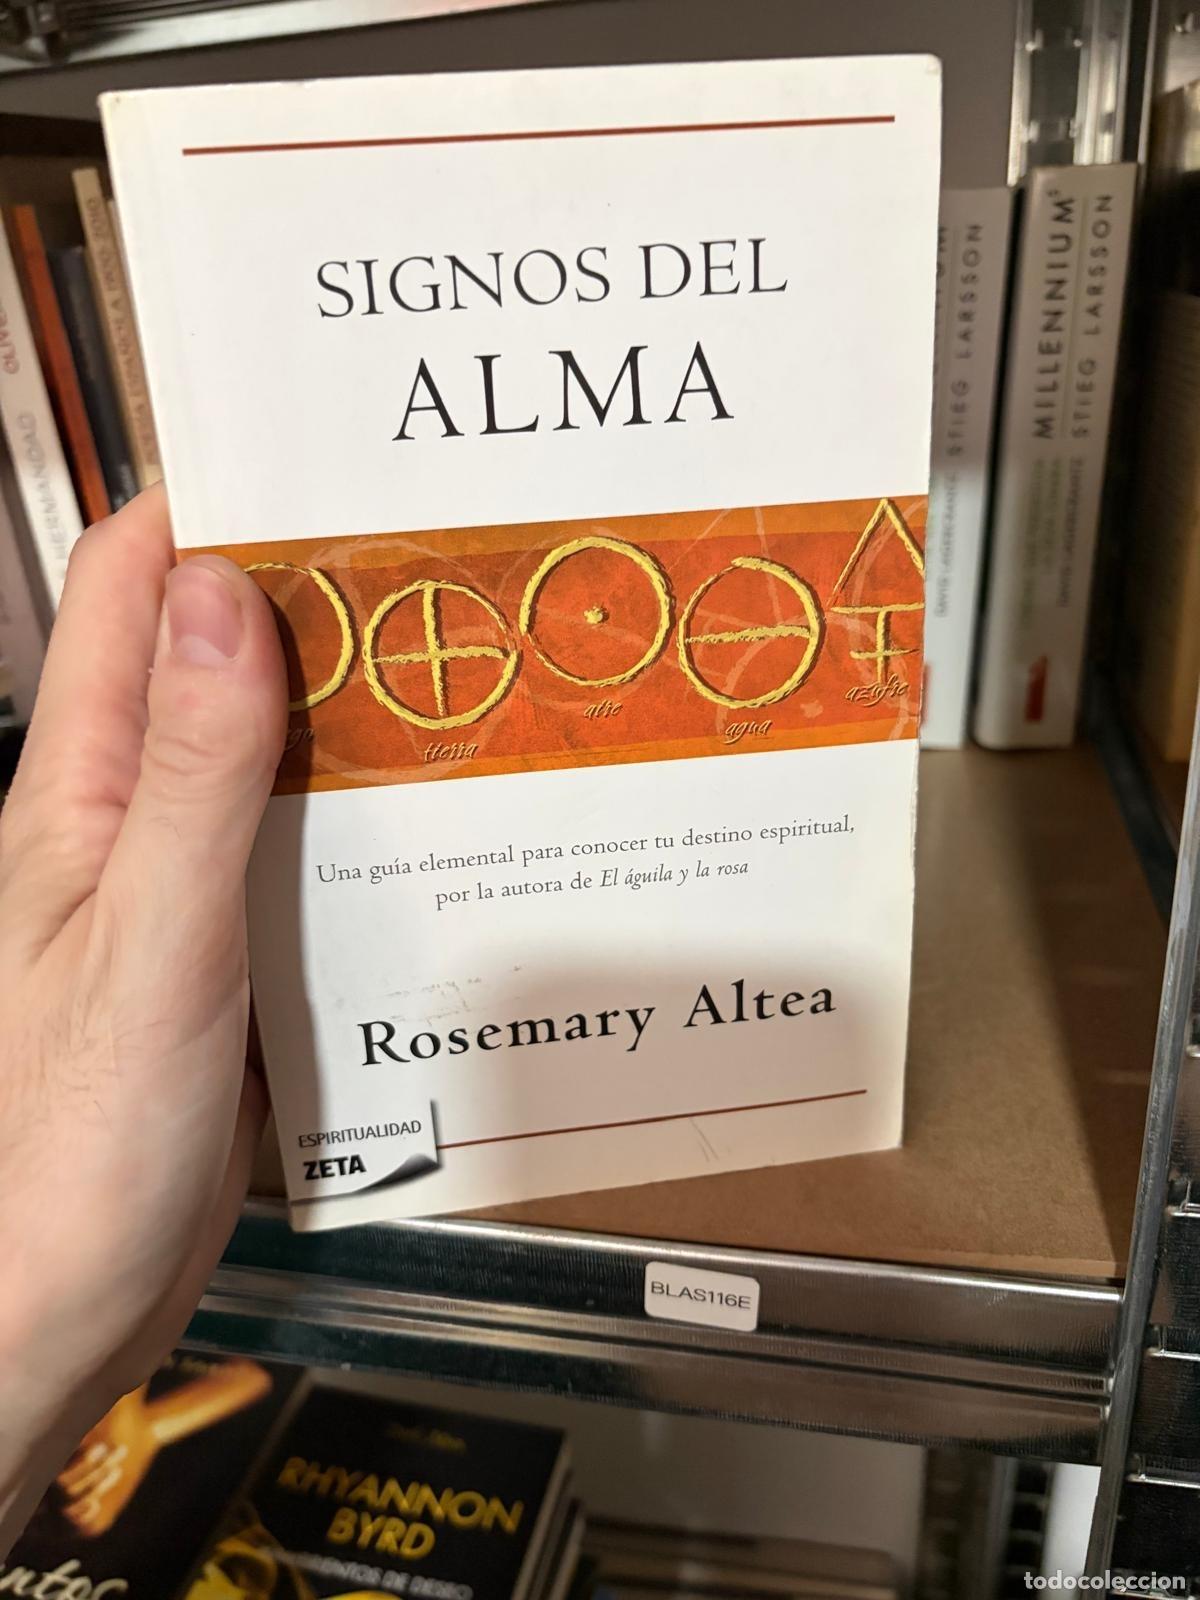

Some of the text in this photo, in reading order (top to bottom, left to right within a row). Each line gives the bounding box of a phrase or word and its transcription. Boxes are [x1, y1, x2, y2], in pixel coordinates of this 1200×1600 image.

[316, 237, 788, 318] SIGNOS DEL
[1070, 194, 1113, 439] STIEG LARSSON
[391, 340, 735, 442] ALMA
[423, 741, 480, 763] tierra
[722, 718, 773, 744] agua
[315, 814, 855, 885] Una guía elemental para conocer tu destino espiritual,
[435, 859, 750, 911] por la autora de El águila y la rosa
[357, 978, 838, 1067] Rosemary Altea
[298, 1119, 422, 1149] ESPIRITUALIDAD
[302, 1153, 367, 1181] ZETA
[650, 1280, 752, 1310] BLAS116E
[277, 1455, 525, 1536] RHYANNON
[326, 1506, 436, 1561] BYRD
